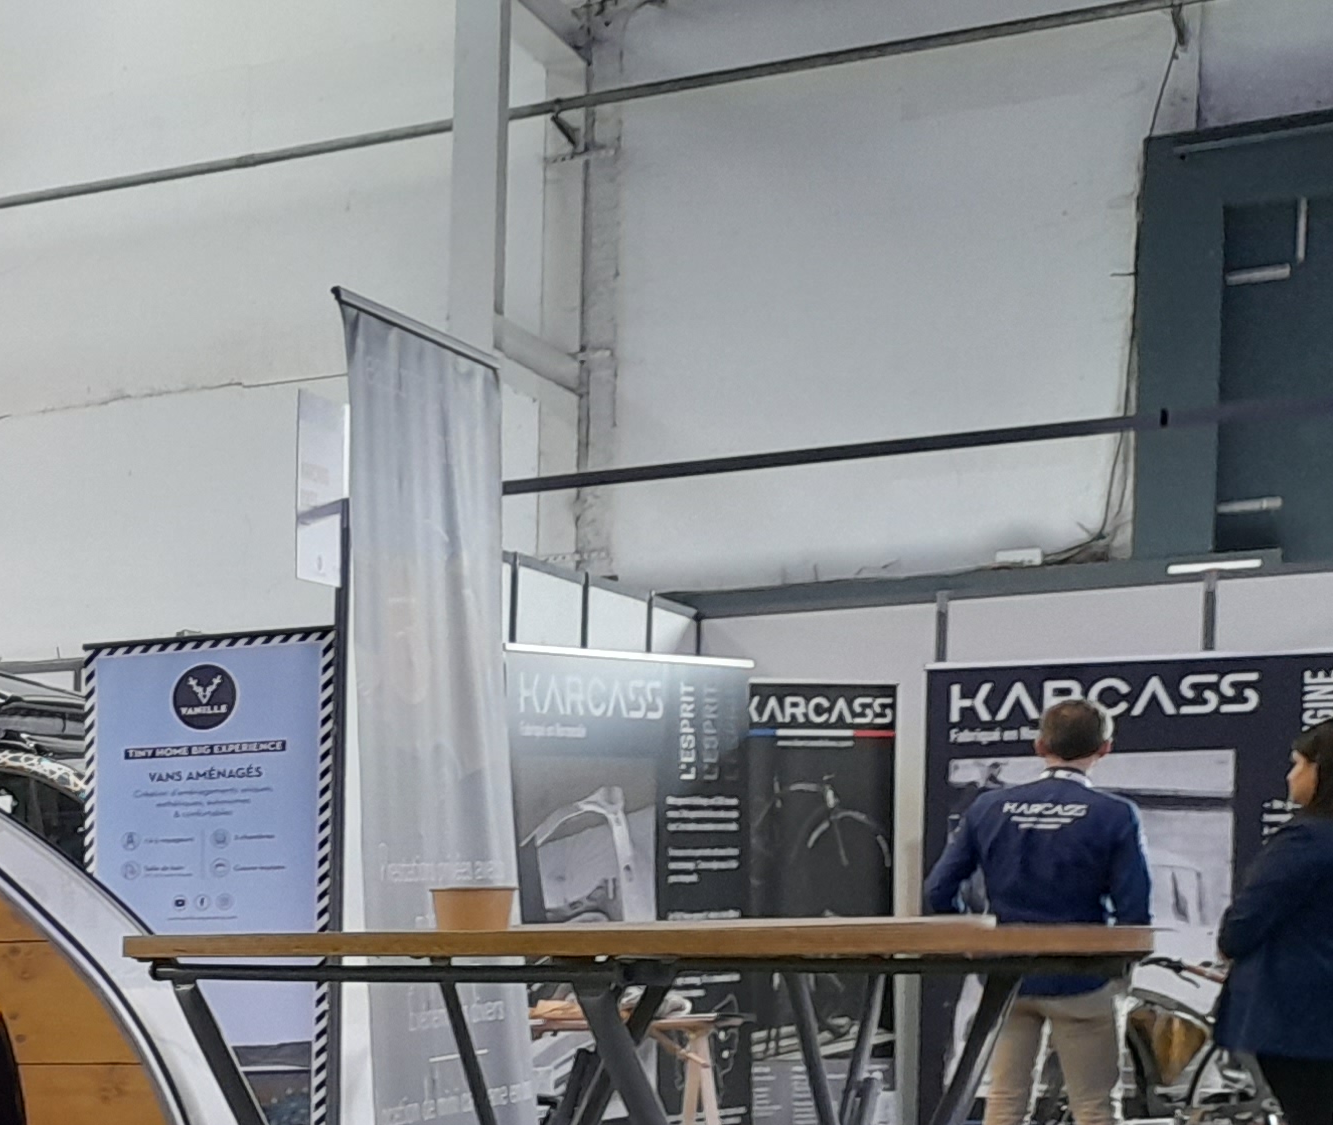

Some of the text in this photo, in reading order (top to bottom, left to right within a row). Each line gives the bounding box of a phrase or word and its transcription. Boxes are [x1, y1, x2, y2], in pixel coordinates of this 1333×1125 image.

[519, 672, 664, 720] KARCASS
[179, 704, 228, 716] VANILLE
[679, 681, 696, 780] L'ESPRIT
[127, 749, 153, 758] TINY
[155, 746, 189, 757] HOME
[191, 745, 211, 755] BIG
[149, 764, 263, 782] VANS AMÉNAGÉS
